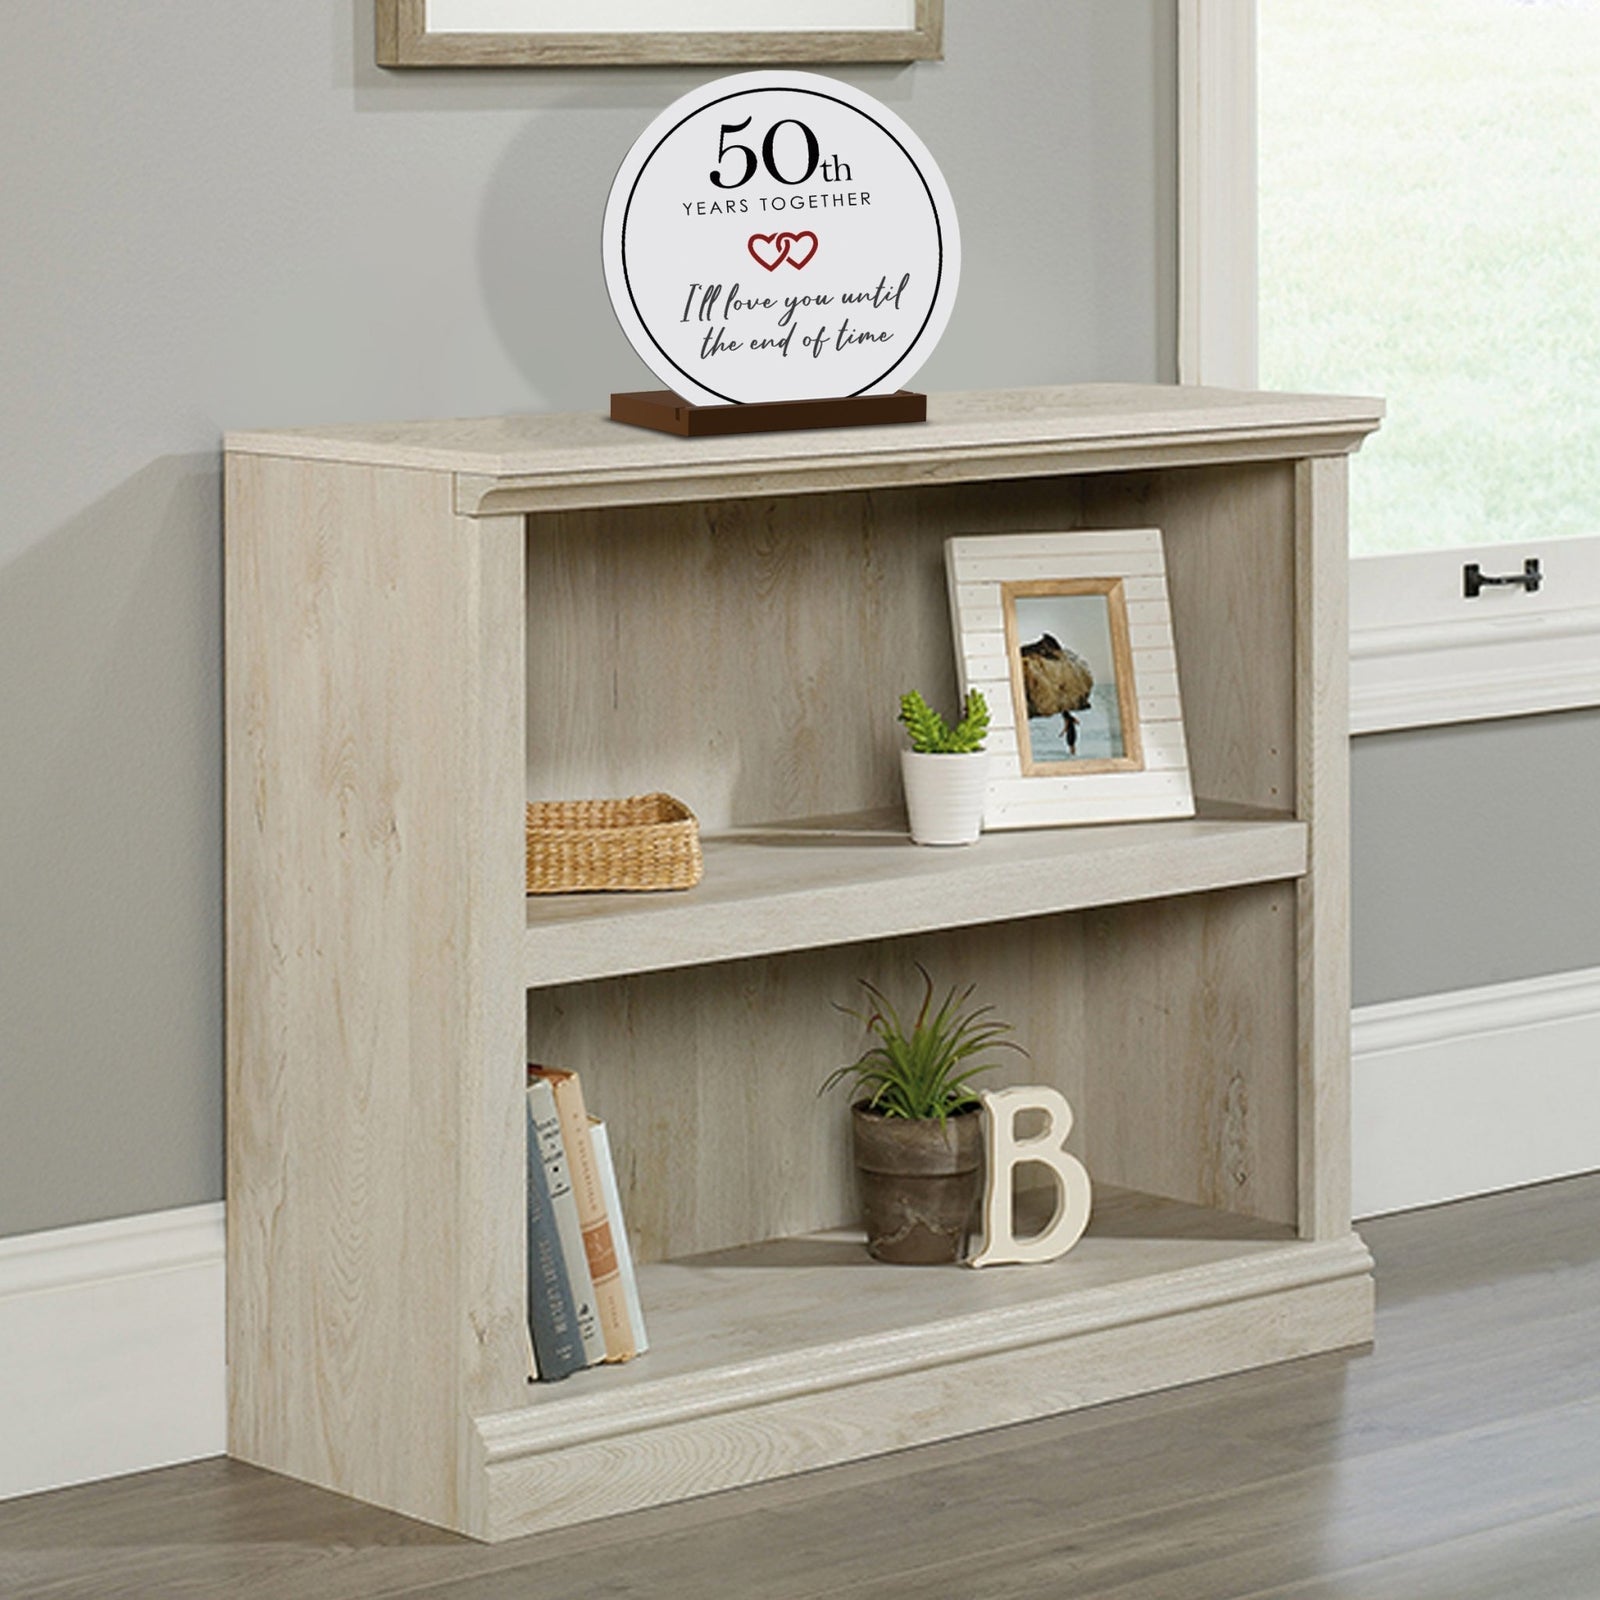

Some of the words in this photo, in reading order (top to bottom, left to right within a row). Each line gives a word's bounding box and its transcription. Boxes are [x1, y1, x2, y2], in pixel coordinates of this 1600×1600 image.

[709, 115, 854, 190] 50th
[682, 198, 749, 216] YEARS
[759, 191, 872, 214] TOGETHER
[723, 282, 778, 321] love
[777, 294, 835, 327] you
[841, 272, 911, 310] until
[700, 326, 744, 360] the
[749, 321, 798, 358] end
[802, 325, 831, 359] of
[835, 318, 894, 352] time
[967, 1085, 1092, 1268] B
